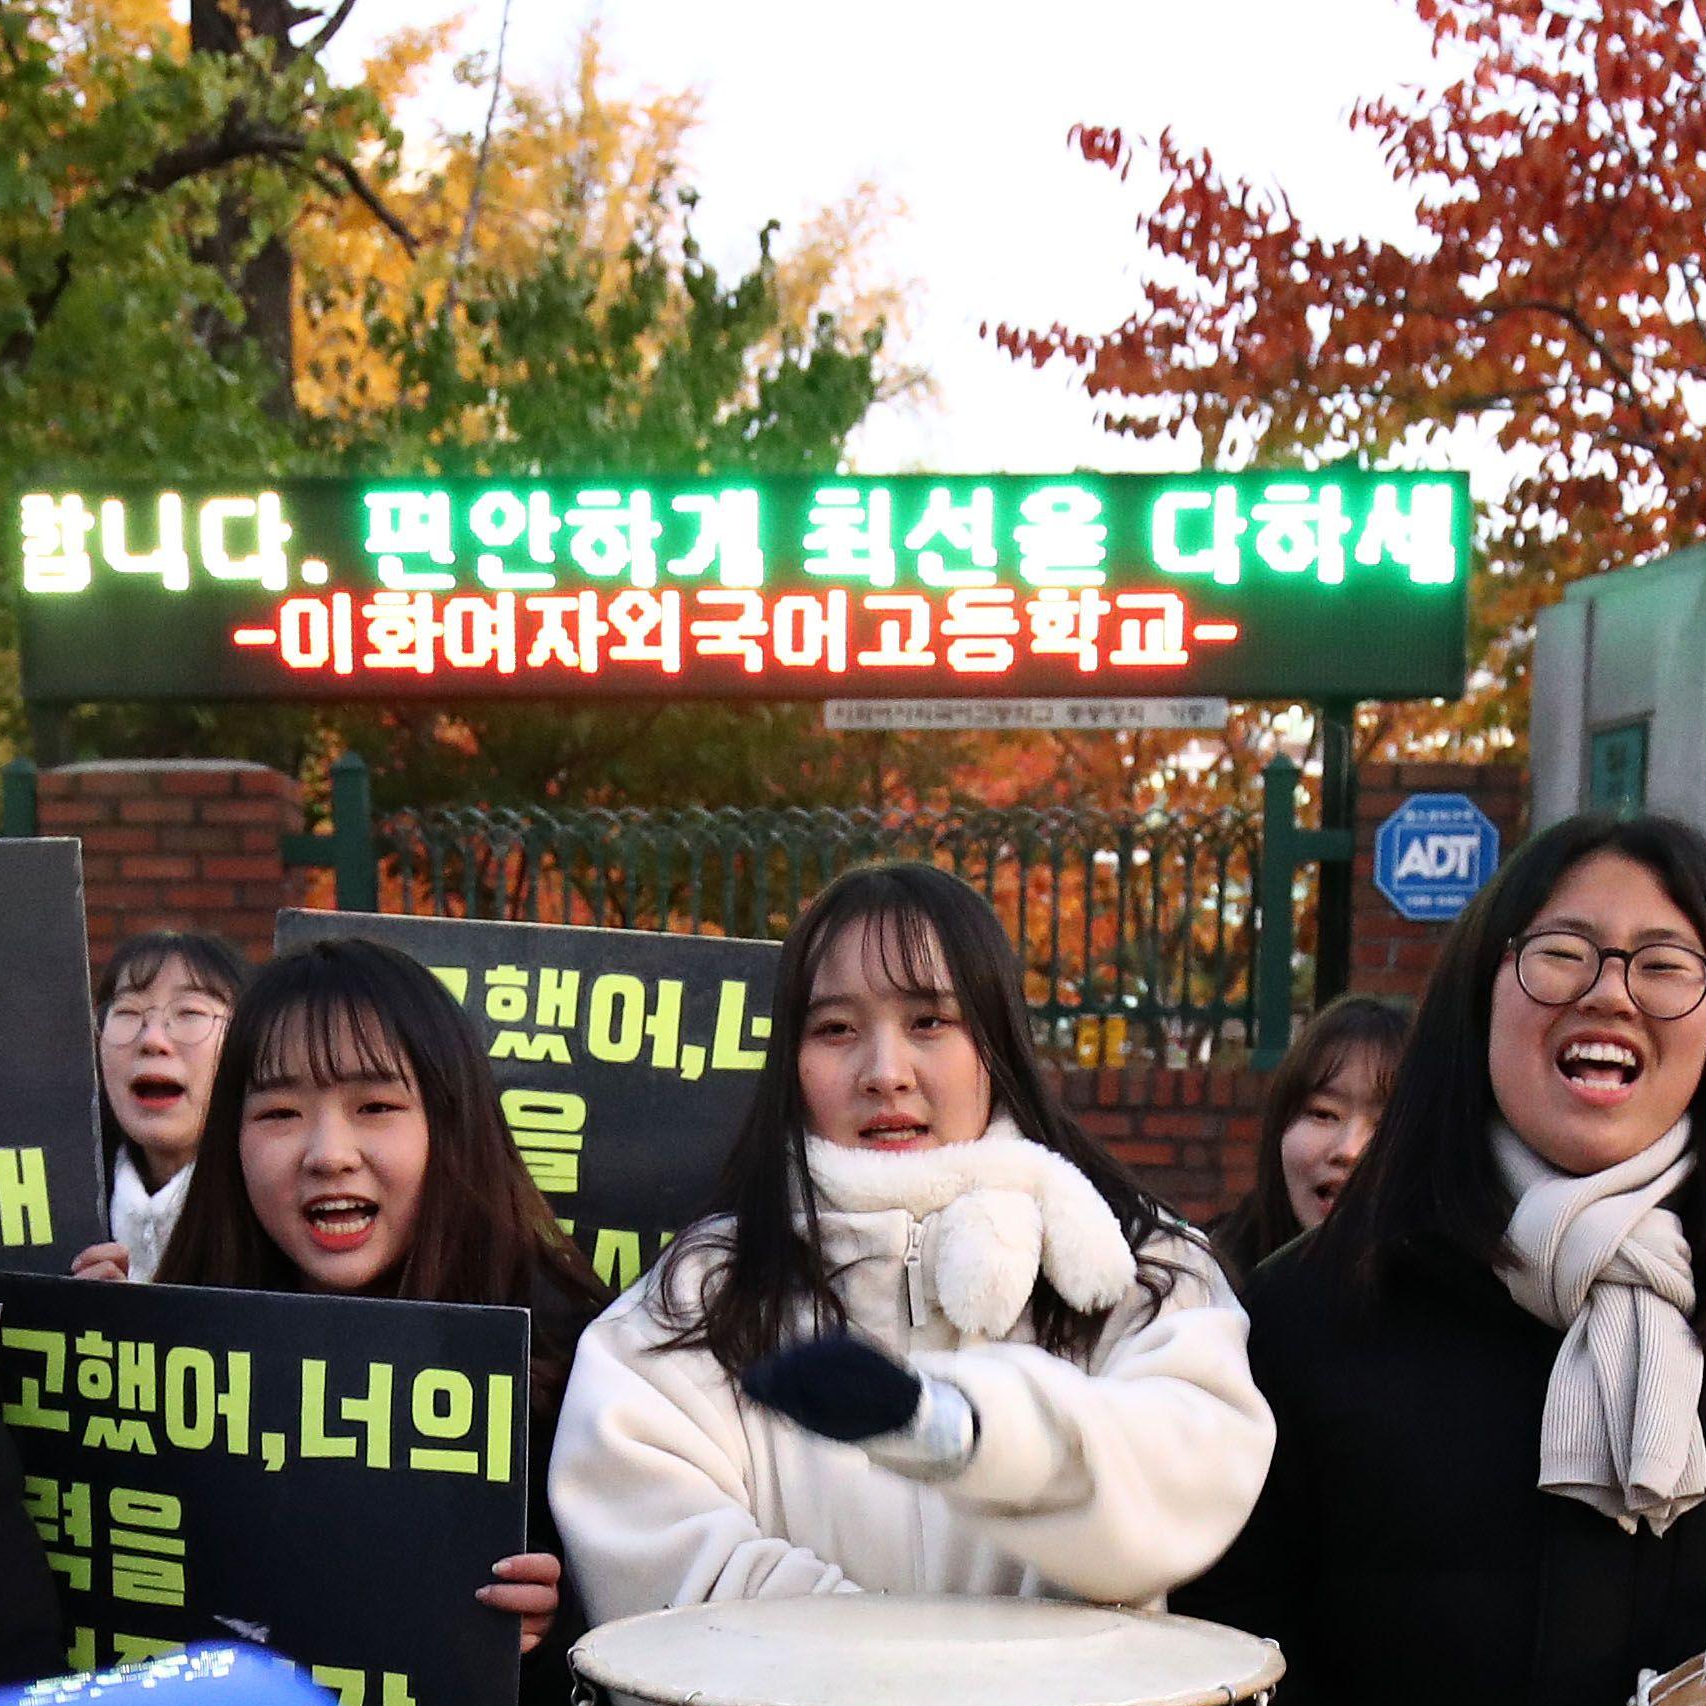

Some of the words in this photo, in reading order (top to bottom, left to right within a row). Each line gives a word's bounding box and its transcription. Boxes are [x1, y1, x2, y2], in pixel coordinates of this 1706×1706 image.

[363, 489, 763, 589] 편안하게
[802, 486, 1107, 588] 최선을
[1150, 484, 1457, 585] 다하세
[1395, 834, 1481, 880] ADT
